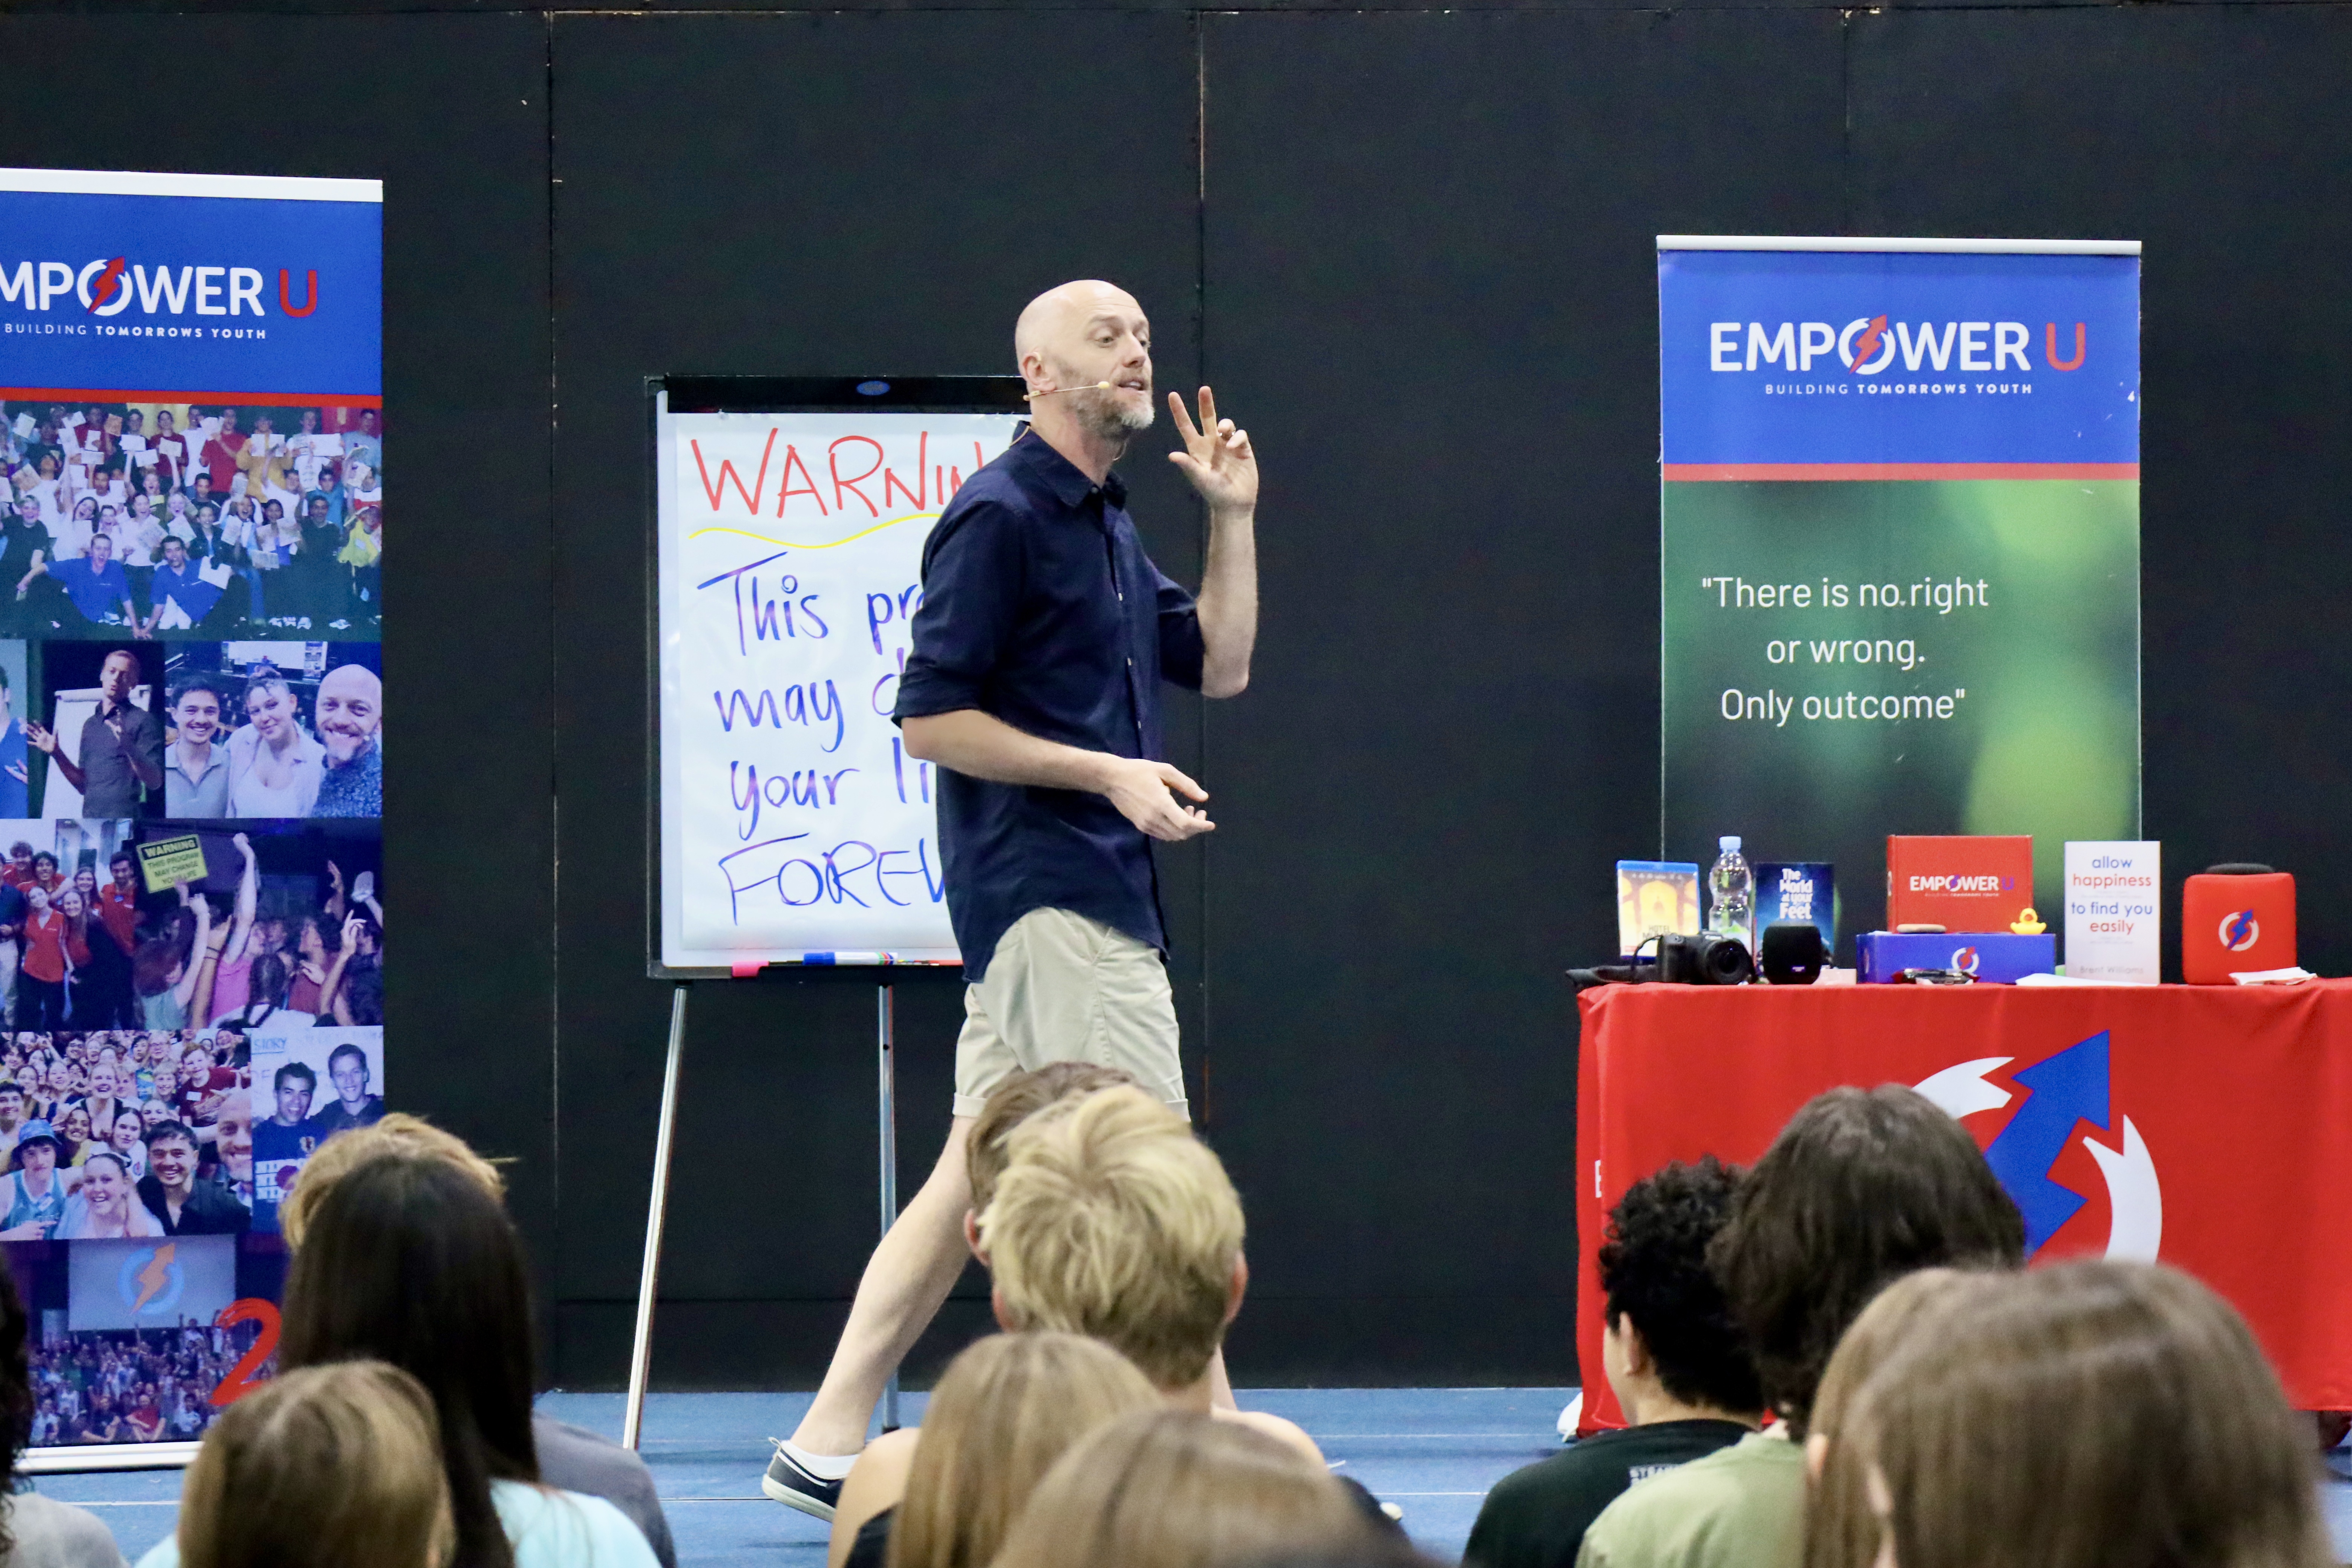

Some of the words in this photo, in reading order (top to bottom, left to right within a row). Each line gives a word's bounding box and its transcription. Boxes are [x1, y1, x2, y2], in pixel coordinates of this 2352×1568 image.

[279, 268, 317, 318] U
[5, 323, 87, 335] BUILDING
[96, 326, 202, 338] TOMORROWS
[211, 328, 266, 339] YOUTH
[1710, 314, 2031, 375] EMPOWER
[2046, 323, 2086, 371] U
[1766, 384, 1848, 395] BUILDING
[1857, 384, 1966, 394] TOMORROWS
[1976, 384, 2032, 394] YOUTH
[697, 551, 829, 656] This
[866, 584, 924, 655] pr
[1702, 577, 1811, 608] "There
[1822, 577, 1849, 607] is
[1911, 576, 1989, 614] right
[1767, 640, 1802, 663] or
[1809, 640, 1925, 671] wrong.
[714, 678, 845, 753] may
[1721, 688, 1793, 727] Only
[1803, 688, 1965, 720] outcome"
[730, 760, 860, 840] your
[144, 839, 196, 858] WARNING
[2092, 856, 2132, 868] allow
[1782, 868, 1801, 880] The
[2073, 873, 2151, 889] happiness
[1779, 879, 1813, 893] World
[1910, 875, 1999, 892] EMPOWER
[2002, 877, 2014, 891] U
[1781, 893, 1790, 902] at
[1790, 893, 1813, 905] your
[1779, 902, 1812, 919] Feet
[2072, 902, 2086, 914] to
[2091, 902, 2119, 914] find
[2124, 905, 2153, 917] you
[2090, 920, 2134, 935] easily
[208, 1298, 282, 1406] 2
